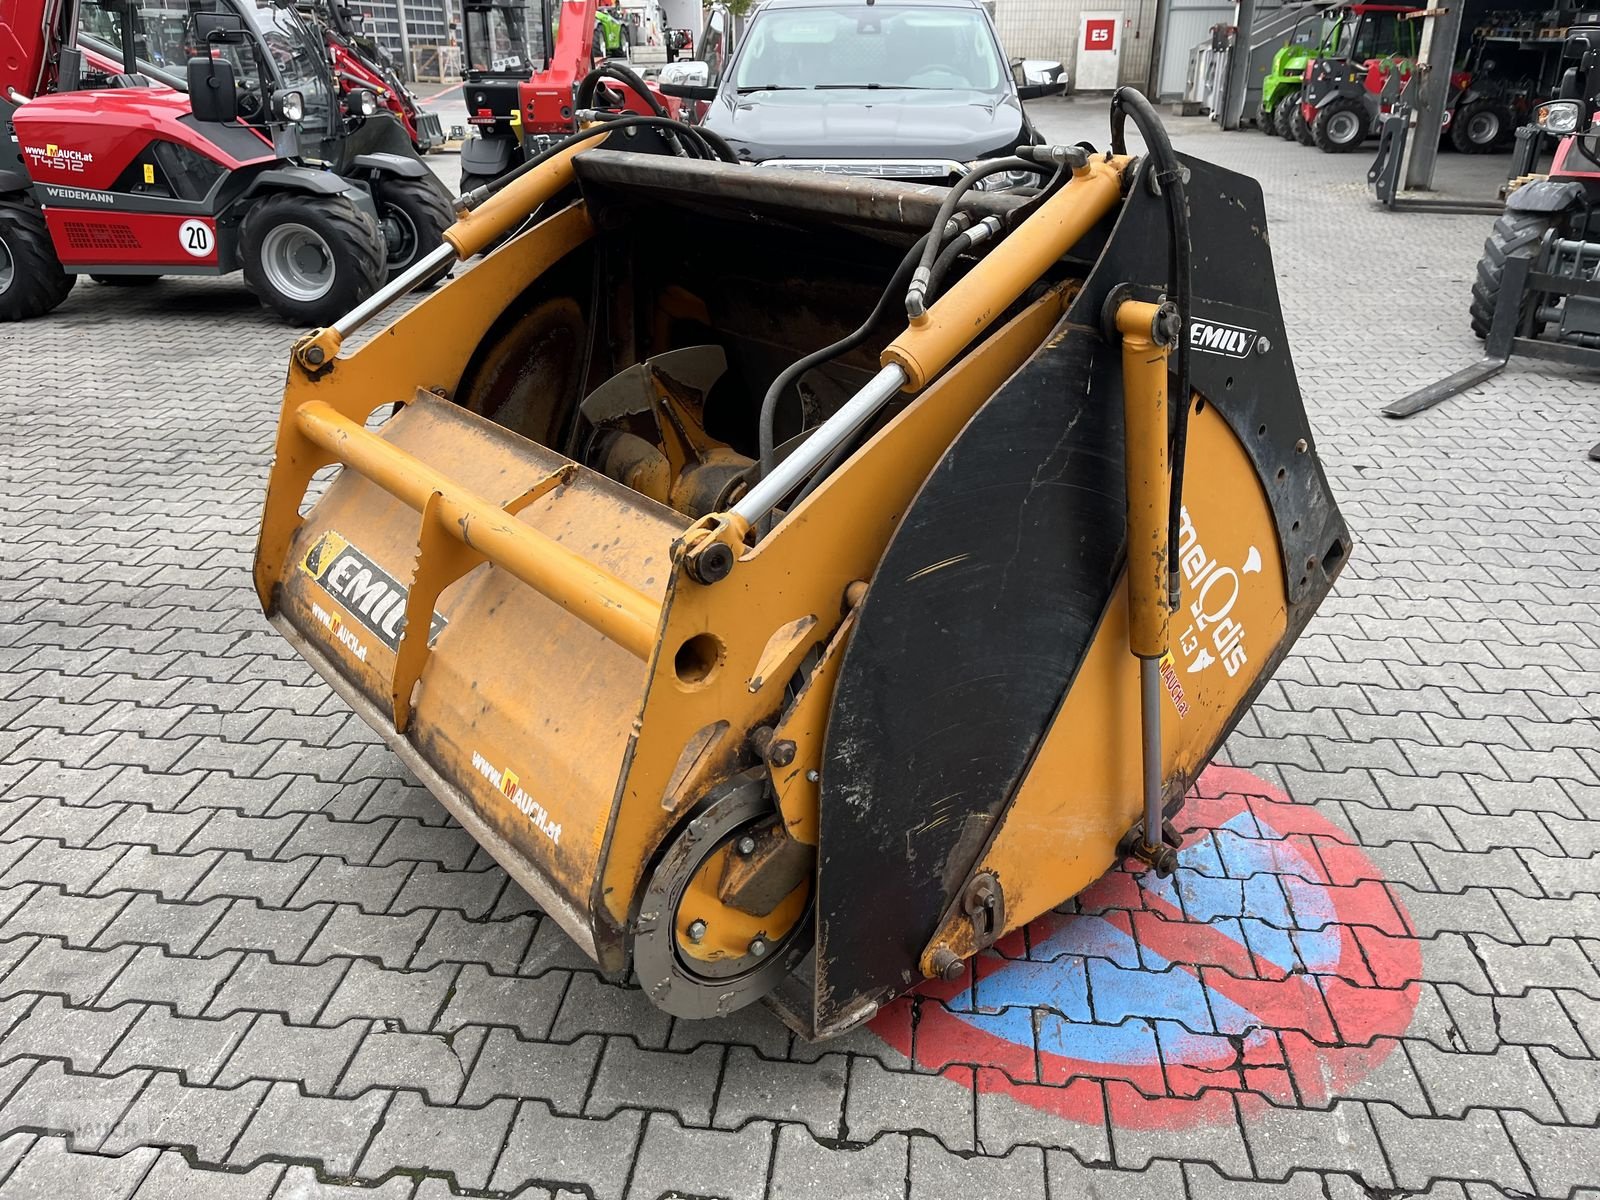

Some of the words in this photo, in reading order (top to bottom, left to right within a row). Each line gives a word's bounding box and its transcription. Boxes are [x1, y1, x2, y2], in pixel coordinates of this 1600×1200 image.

[1091, 29, 1108, 42] E5
[25, 146, 93, 162] www.MAUCH.at
[30, 154, 84, 172] T4512
[46, 187, 114, 204] WEIDEMANN
[186, 226, 207, 249] 20
[1190, 322, 1252, 353] EMILY
[327, 555, 438, 640] EMIL
[311, 602, 368, 663] www.MAUCH.at
[1179, 623, 1199, 657] 1.3
[472, 750, 562, 846] www.MAUCH.at
